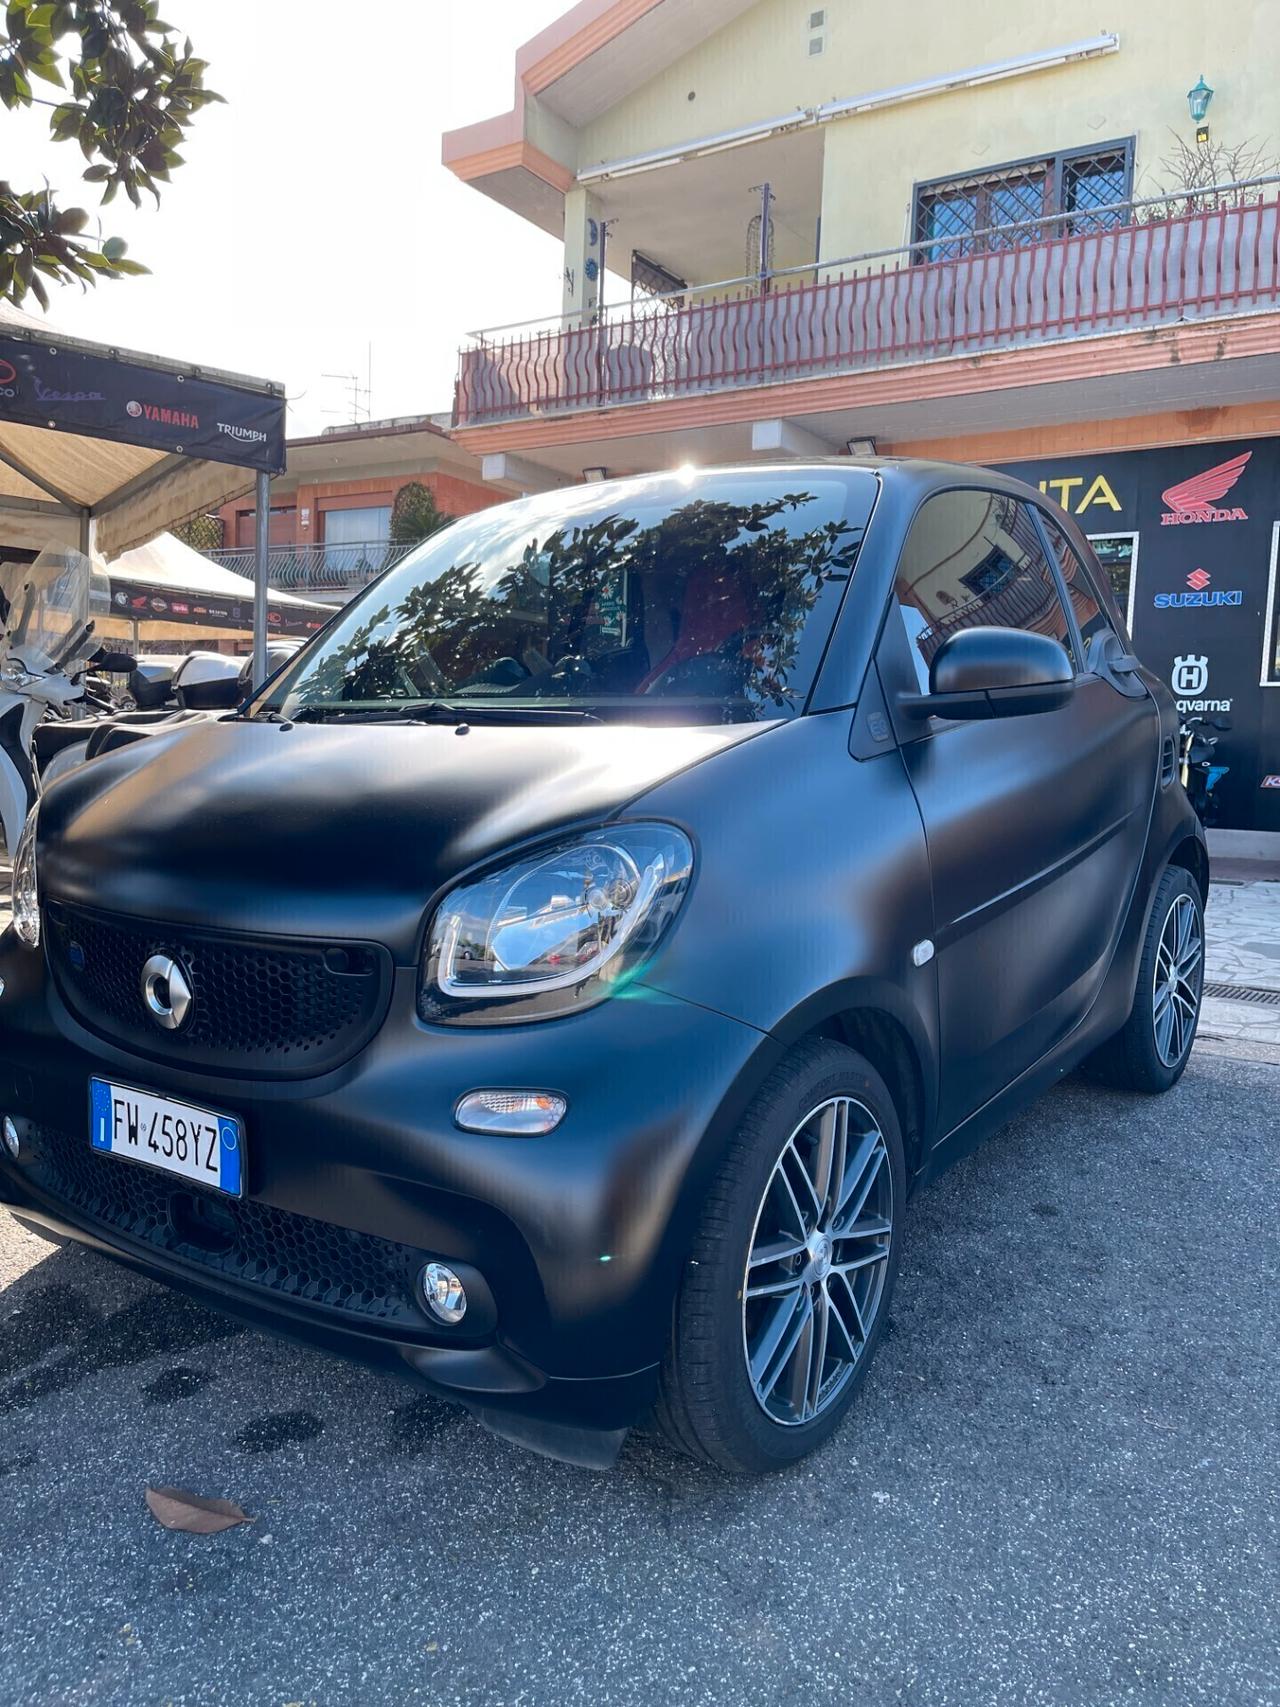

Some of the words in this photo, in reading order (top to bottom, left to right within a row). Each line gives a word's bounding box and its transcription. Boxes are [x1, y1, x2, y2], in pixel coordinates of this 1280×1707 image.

[143, 404, 199, 429] YAMAHA
[217, 422, 267, 442] TRIUMPH
[1161, 508, 1248, 525] HONDA
[1154, 590, 1243, 608] SUZUKI
[114, 1099, 138, 1146] FW
[148, 1112, 218, 1172] 458YZ
